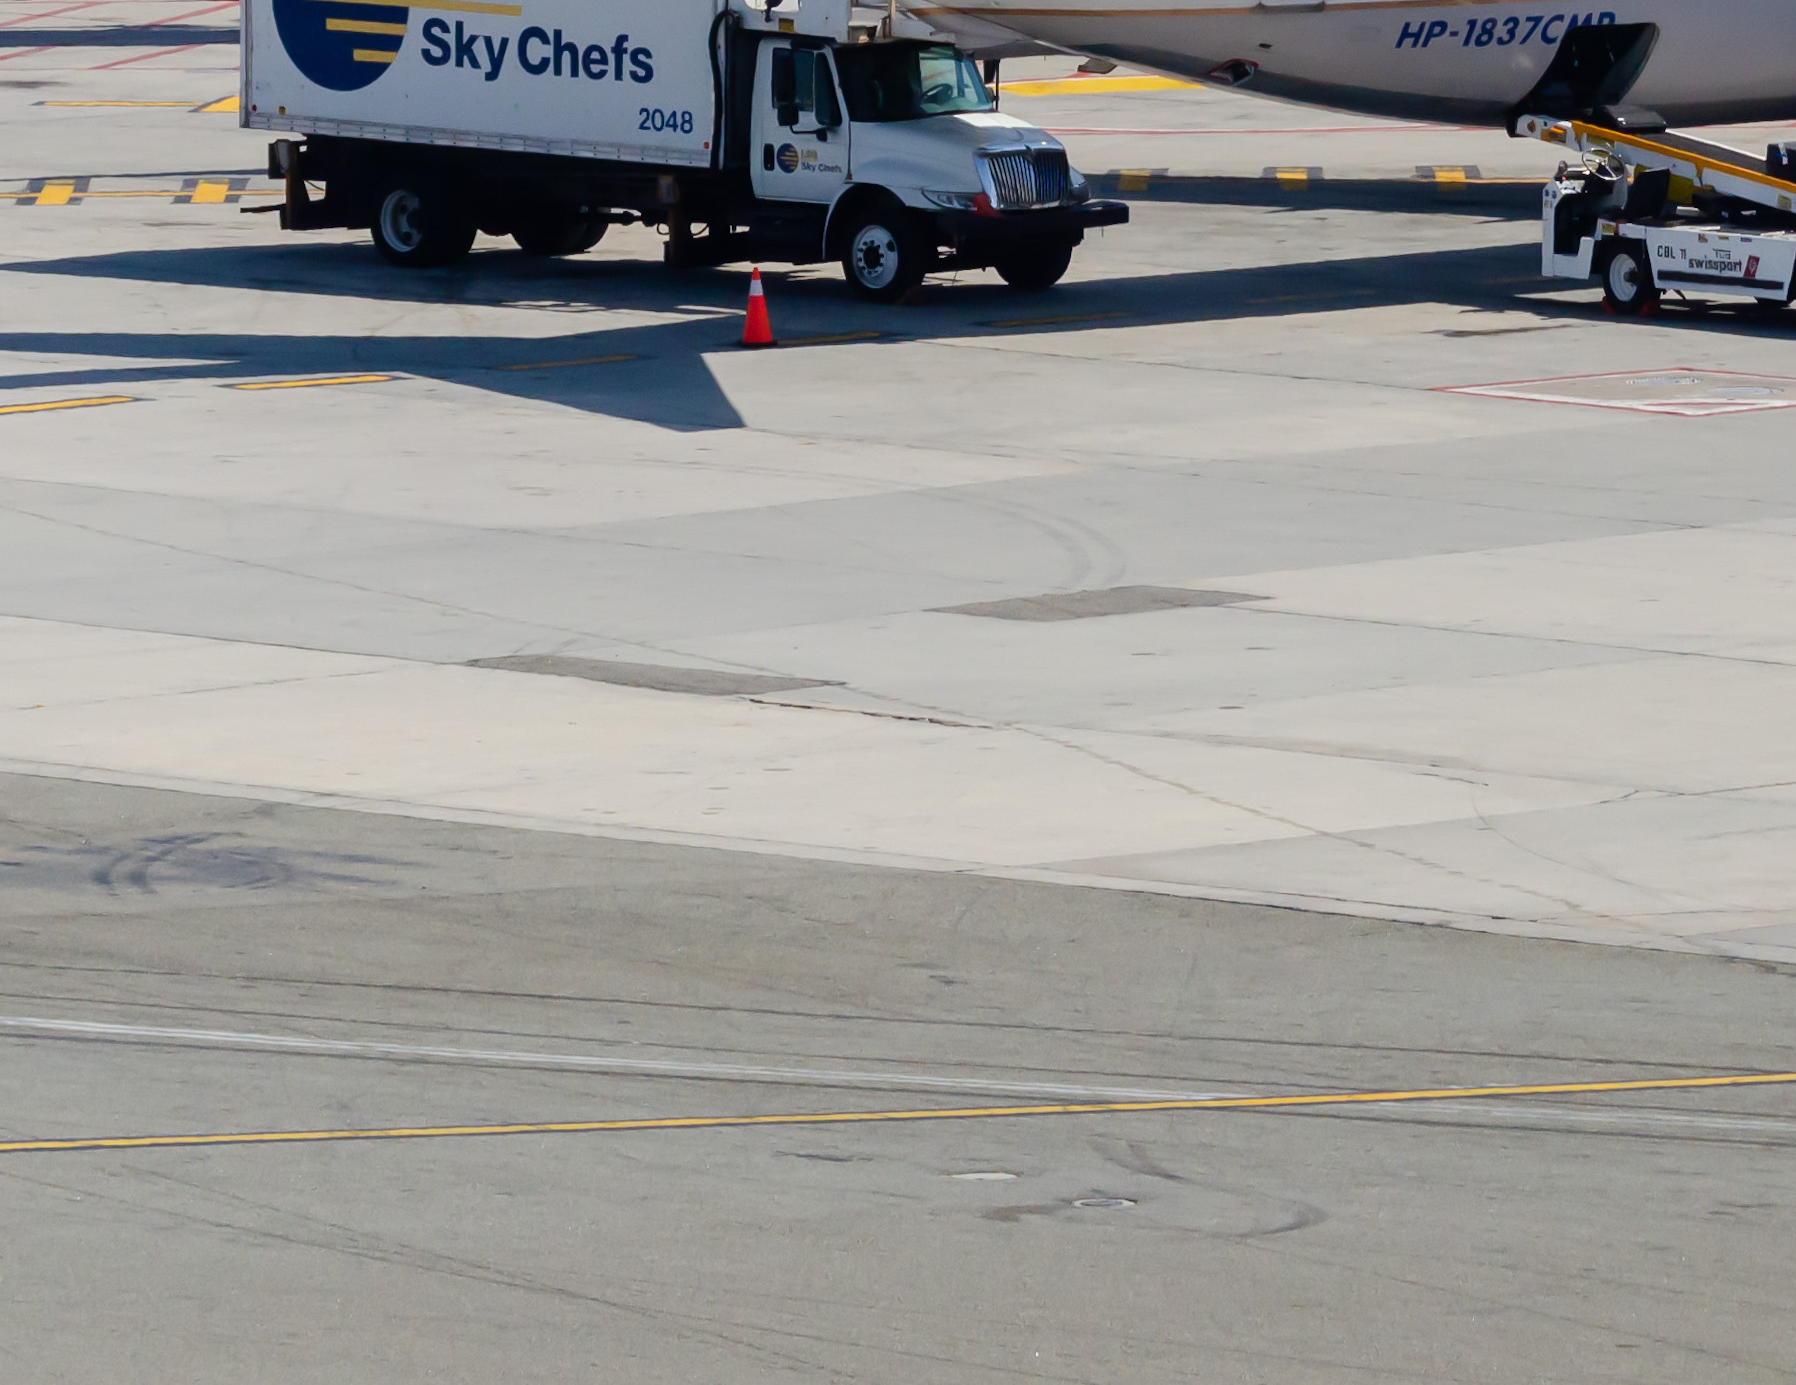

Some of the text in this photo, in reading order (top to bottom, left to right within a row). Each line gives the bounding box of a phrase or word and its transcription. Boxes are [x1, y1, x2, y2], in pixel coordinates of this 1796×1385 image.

[421, 17, 655, 84] Sky Chefs
[638, 107, 694, 134] 2048
[1657, 245, 1676, 260] CBL
[1688, 255, 1743, 273] swissport
